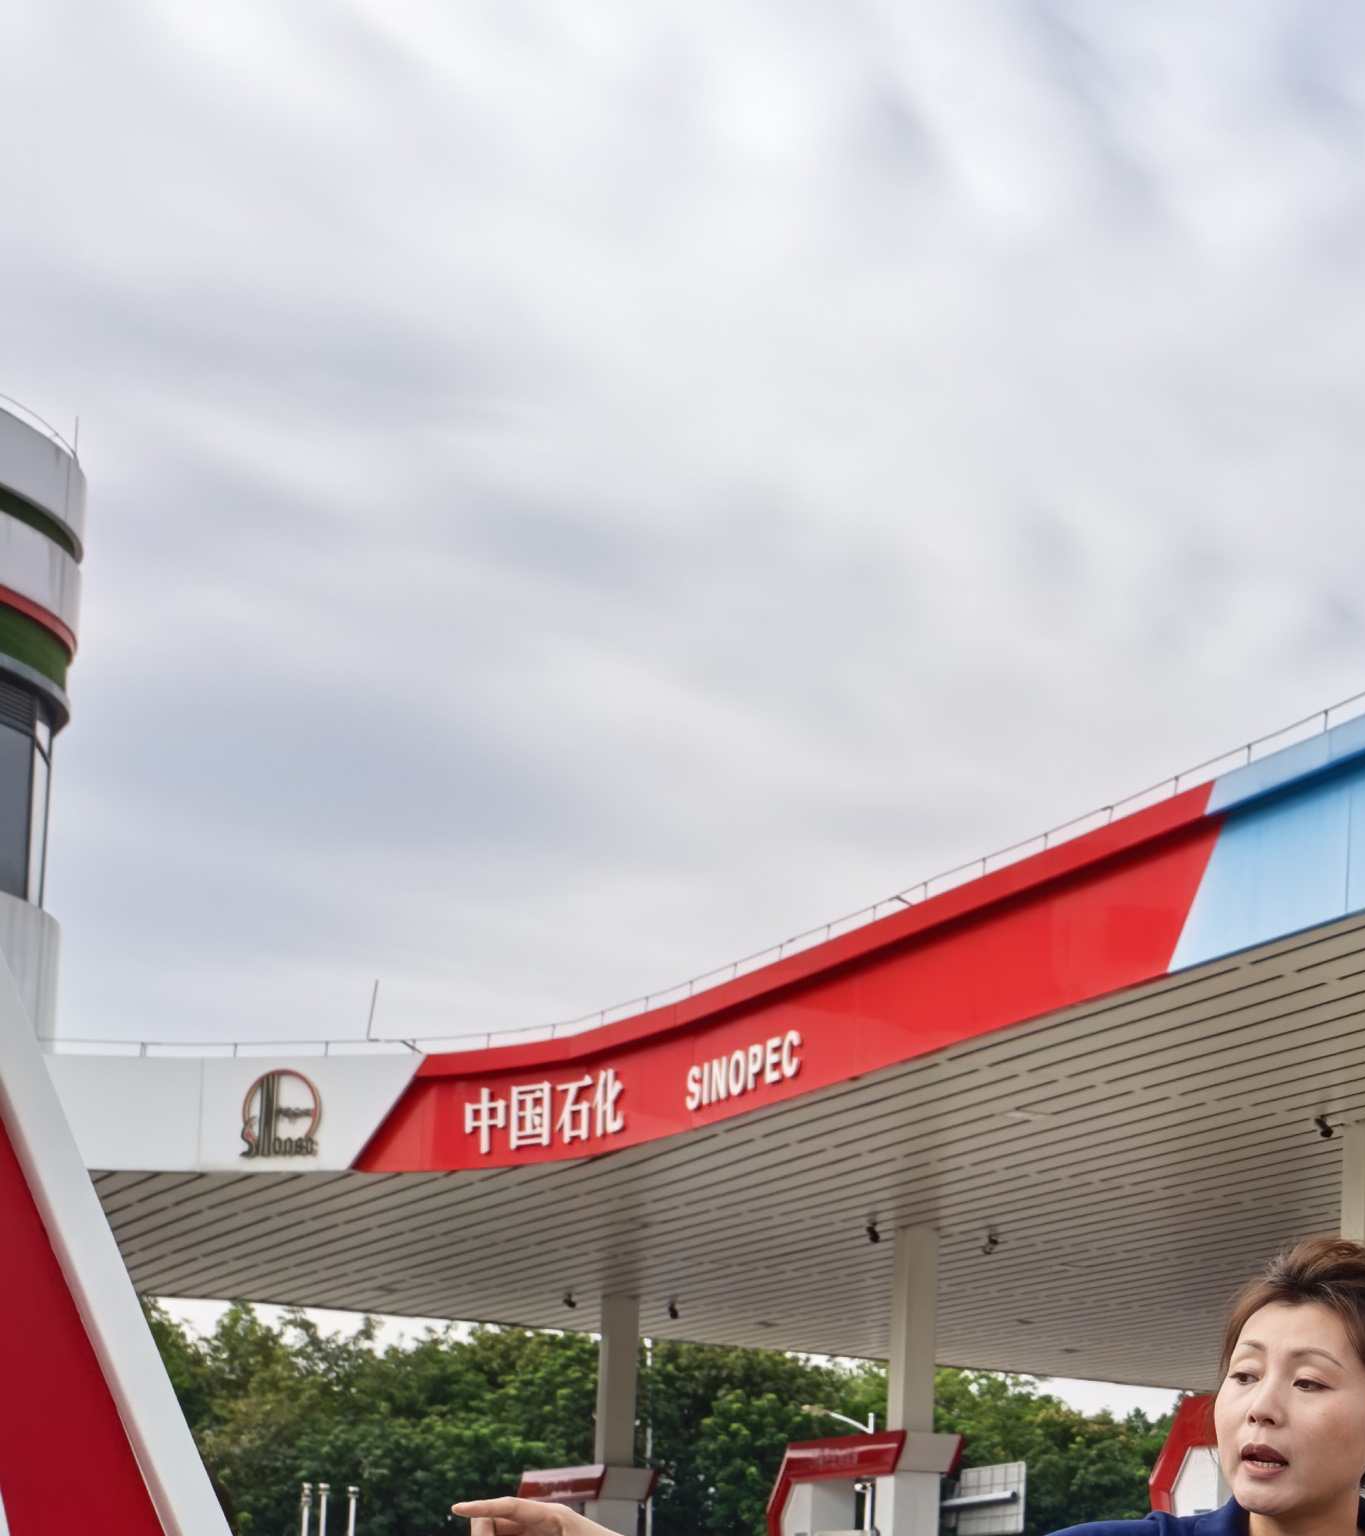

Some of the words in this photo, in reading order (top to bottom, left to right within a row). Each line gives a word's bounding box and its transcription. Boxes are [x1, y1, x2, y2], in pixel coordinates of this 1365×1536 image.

[463, 1067, 625, 1156] 中国石化
[685, 1029, 802, 1113] SINOPEC
